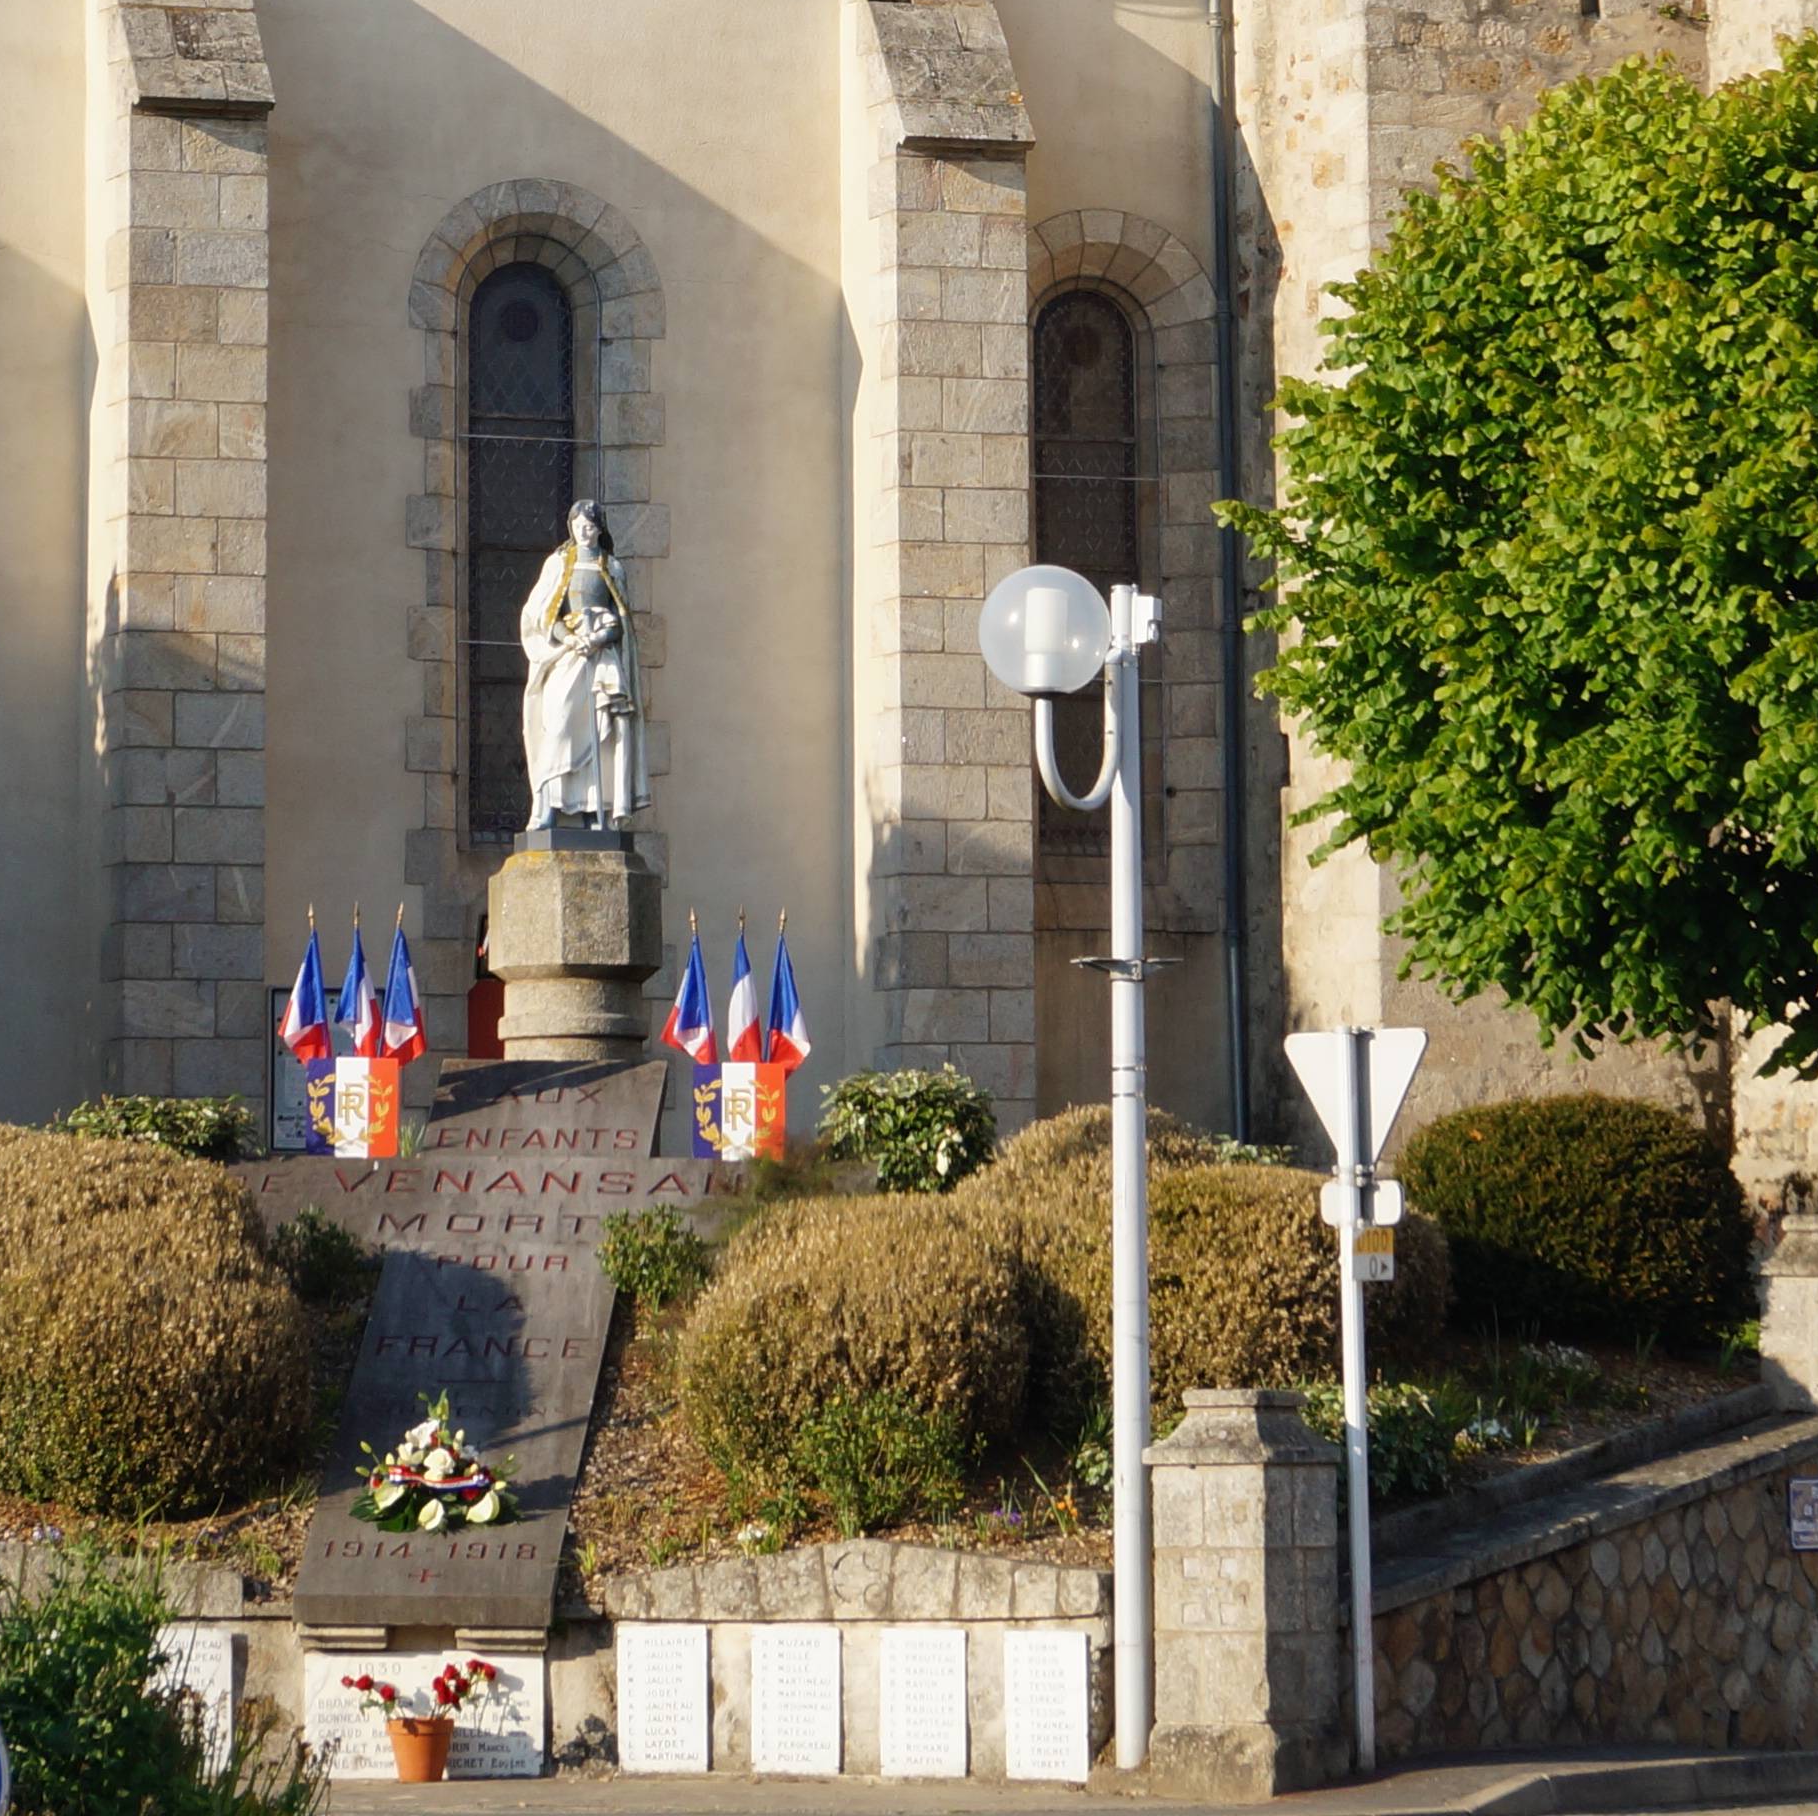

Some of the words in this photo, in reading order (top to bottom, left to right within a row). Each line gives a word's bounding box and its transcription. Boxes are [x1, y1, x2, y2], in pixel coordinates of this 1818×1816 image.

[437, 1127, 639, 1150] ENFANTS
[378, 1212, 599, 1235] MORT
[437, 1254, 569, 1272] POUR
[457, 1295, 524, 1312] LA
[375, 1335, 589, 1358] FRANCE
[645, 1664, 682, 1672] JAULIN
[645, 1728, 677, 1736] LUCAS
[645, 1753, 699, 1761] MARTINEAU
